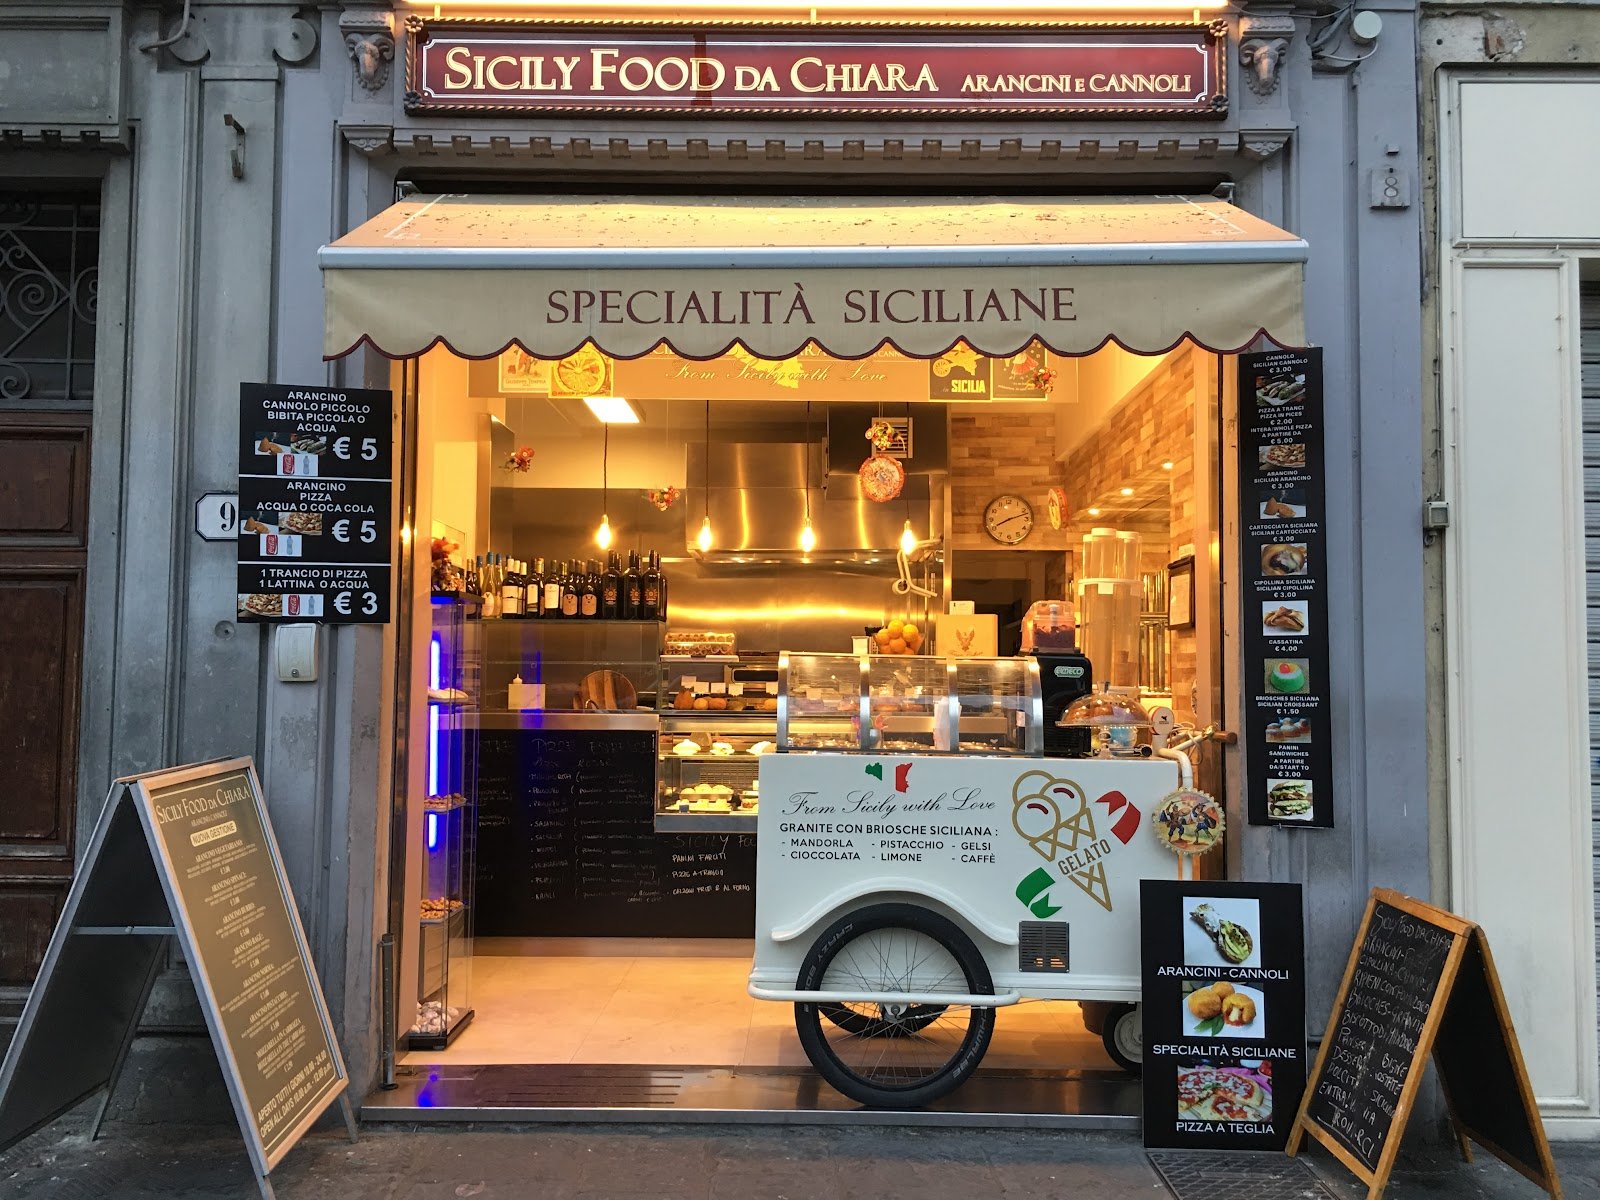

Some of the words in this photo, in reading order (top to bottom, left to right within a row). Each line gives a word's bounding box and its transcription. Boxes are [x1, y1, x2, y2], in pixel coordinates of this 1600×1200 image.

[444, 48, 581, 91] SICILY
[591, 49, 725, 92] FOOD
[736, 67, 779, 91] DA
[791, 57, 939, 92] CHIARA
[960, 74, 1071, 93] ARANCINI
[1076, 79, 1084, 93] E
[1089, 74, 1191, 93] CANNOLI
[1384, 177, 1398, 197] 8
[547, 283, 816, 324] SPECIALITÀ
[844, 288, 1077, 324] SICILIANE
[951, 379, 986, 393] SICILIA
[288, 391, 346, 401] ARANCINO
[263, 401, 318, 411] CANNOLO
[321, 403, 370, 413] PICCOLO
[268, 412, 303, 421] BIBITA
[307, 413, 356, 423] PICCOLA
[297, 424, 336, 432] ACQUA
[333, 437, 350, 459] €
[361, 438, 377, 460] 5
[287, 482, 346, 491] ARANCINO
[300, 493, 332, 501] PIZZA
[257, 502, 296, 511] ACQUA
[300, 503, 307, 512] O
[310, 504, 342, 512] COCA
[344, 505, 374, 513] COLA
[220, 502, 236, 531] 9
[332, 519, 350, 542] €
[360, 521, 376, 542] 5
[261, 569, 265, 577] 1
[269, 569, 320, 577] TRANCIO
[336, 570, 367, 578] PIZZA
[267, 580, 314, 588] LATTINA
[320, 580, 327, 588] O
[330, 580, 369, 589] ACQUA
[334, 592, 351, 614] €
[362, 592, 377, 614] 3
[156, 804, 183, 824] SICILY
[182, 798, 207, 816] FOOD
[216, 786, 250, 806] CHIARA
[782, 791, 836, 817] From
[841, 790, 897, 820] Sicily
[903, 793, 947, 811] with
[947, 787, 997, 811] Love
[192, 831, 209, 845] NUOVA
[210, 823, 235, 837] GESTIONE
[780, 823, 834, 833] GRANITE
[836, 824, 863, 833] CON
[866, 824, 928, 835] BRIOSCHE
[930, 826, 992, 836] SICILIANA
[791, 839, 853, 847] MANDORLA
[881, 840, 943, 850] PISTACCHIO
[961, 842, 991, 851] GELSI
[791, 851, 860, 860] CIOCCOLATA
[881, 853, 922, 862] LIMONE
[961, 853, 996, 863] CAFFÈ
[1058, 838, 1111, 875] GELATO
[1157, 967, 1221, 977] ARANCINI
[1229, 969, 1288, 979] CANNOLI
[1153, 1044, 1229, 1056] SPECIALITÀ
[1232, 1047, 1296, 1058] SICILIANE
[258, 1098, 277, 1123] APERTO
[260, 1118, 275, 1138] OPEN
[273, 1110, 283, 1125] ALL
[282, 1098, 294, 1116] DAYS
[1177, 1122, 1213, 1132] PIZZA
[1216, 1123, 1225, 1132] A
[1228, 1124, 1274, 1134] TEGLIA
